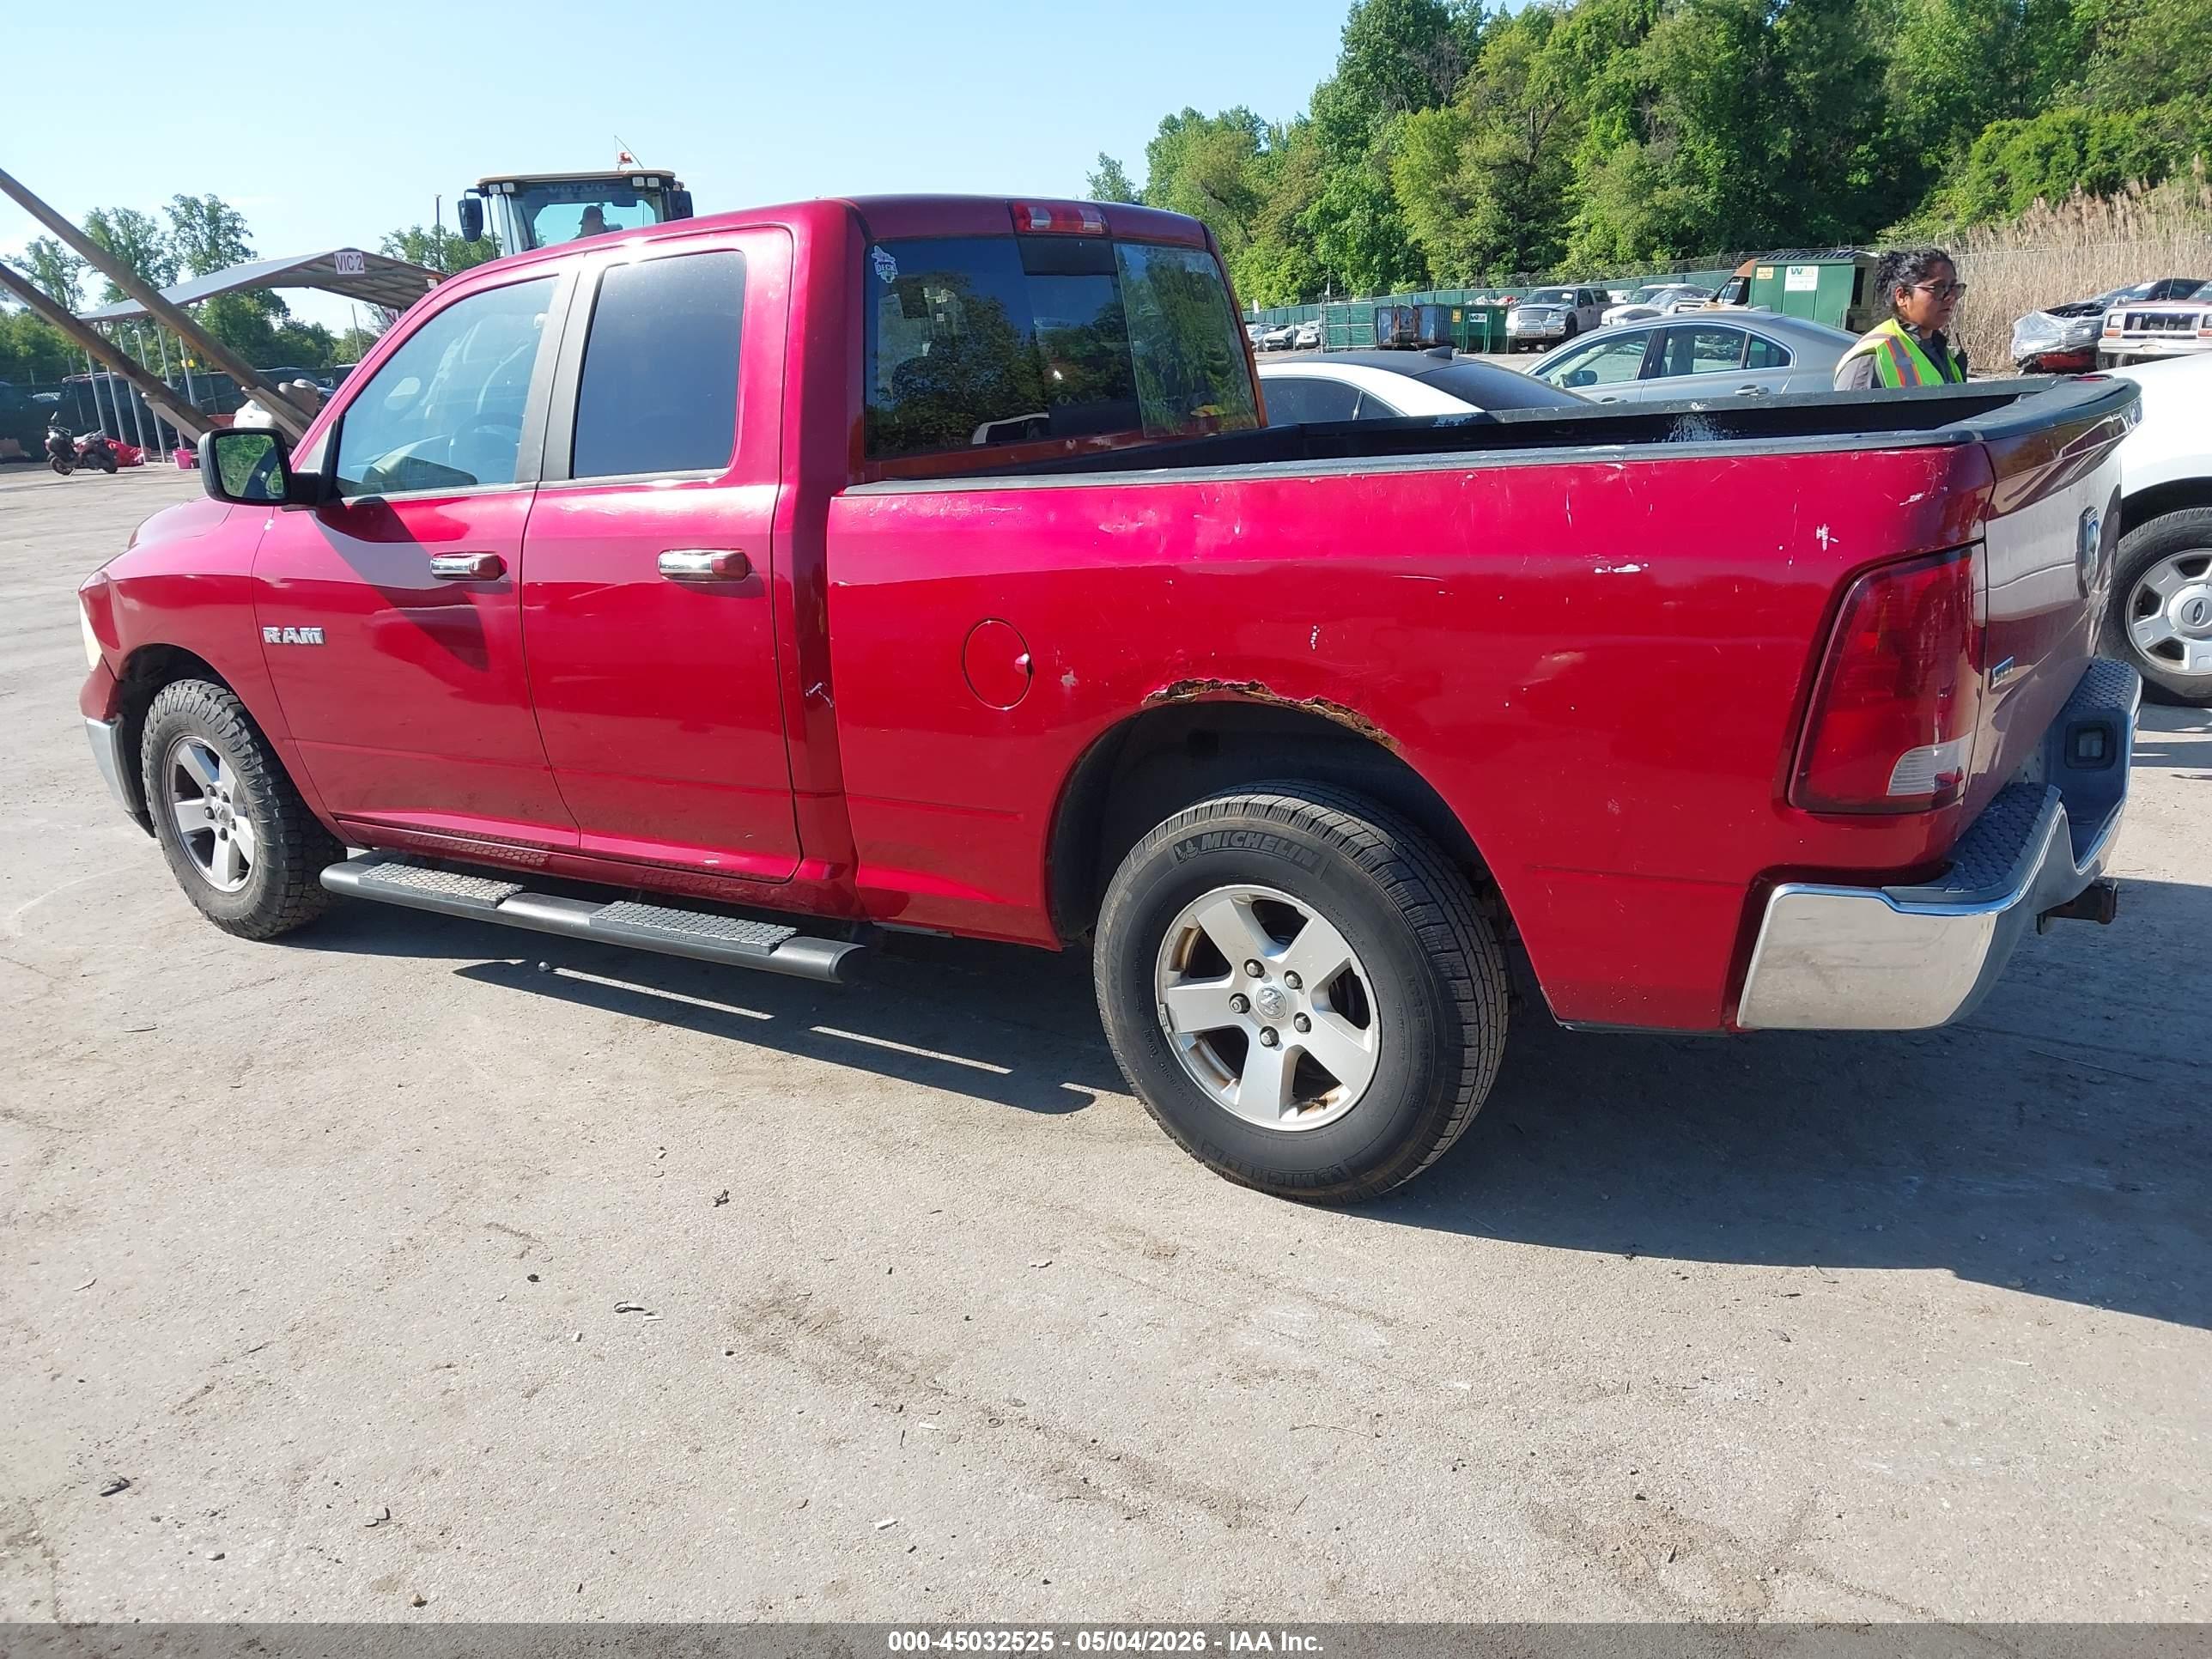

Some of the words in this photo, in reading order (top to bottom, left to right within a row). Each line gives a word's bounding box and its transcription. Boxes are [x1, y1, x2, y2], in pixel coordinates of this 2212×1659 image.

[336, 254, 355, 271] VIC
[356, 254, 364, 271] 2
[262, 627, 325, 644] RAM
[1202, 830, 1322, 868] MICHELIN
